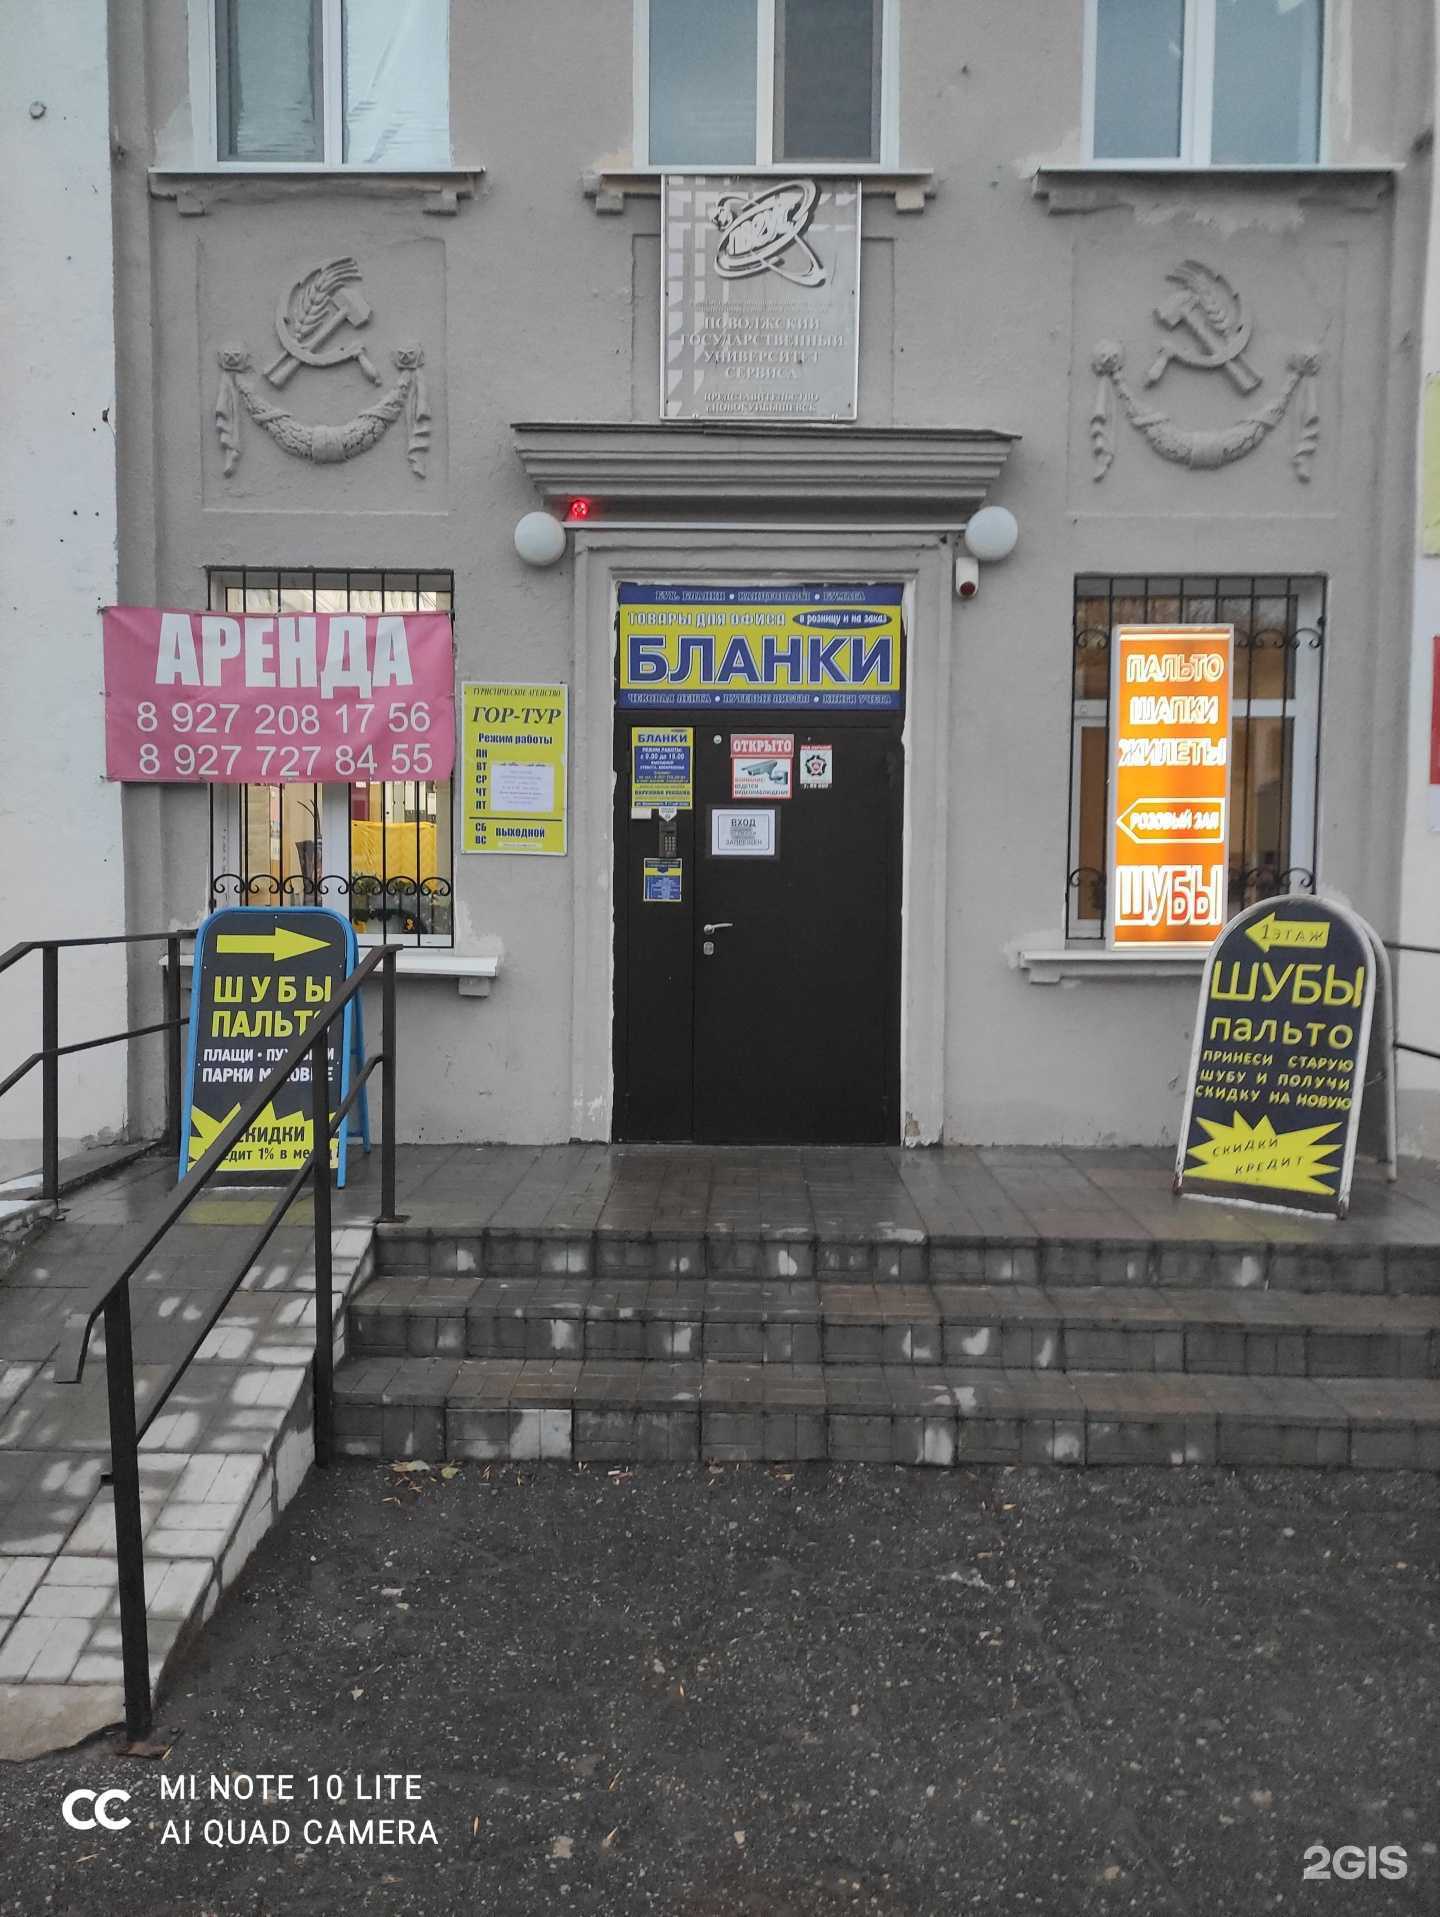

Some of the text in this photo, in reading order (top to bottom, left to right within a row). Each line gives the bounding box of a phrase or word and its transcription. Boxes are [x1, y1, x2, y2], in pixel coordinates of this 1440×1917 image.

[704, 316, 821, 330] ПОВОЛЖСКИЙ
[681, 333, 845, 347] ГОСУДАРСТВЕННЫЙ
[704, 350, 820, 363] УНИВЕРСИТЕТ
[725, 367, 798, 379] СЕРВИСА
[628, 612, 692, 626] ТОВАРЫ
[696, 612, 726, 629] ДЛЯ
[731, 612, 786, 627] ОФИСА
[807, 614, 841, 627] розницу
[843, 614, 849, 623] и
[851, 614, 862, 623] на
[864, 614, 888, 623] заказ
[155, 613, 414, 699] АРЕНДА
[628, 635, 893, 685] БЛАНКИ
[1126, 654, 1224, 682] ПАЛЬТО
[473, 687, 526, 697] ТУРИСТИЧЕСКОЕ
[137, 702, 431, 735] 8 927 208 17 56
[472, 706, 562, 724] ГОР-ТУР
[1129, 696, 1218, 725] ШАПКИ
[478, 732, 553, 745] Режим работы
[638, 734, 688, 743] БЛАНКИ
[733, 740, 792, 753] ОТКРЫТО
[139, 743, 433, 777] 8 927 727 84 55
[1118, 738, 1227, 767] ЖИЛЕТЫ
[476, 762, 487, 771] ВТ
[476, 775, 487, 784] СР
[476, 788, 487, 797] ЧТ
[476, 800, 487, 810] ПТ
[475, 823, 487, 832] СБ
[731, 819, 756, 828] ВХОД
[1115, 865, 1224, 926] ШУБЫ
[213, 975, 332, 1003] ШУБЫ
[1210, 961, 1366, 1008] ШУБЫ
[211, 1010, 329, 1038] ПАЛЬТ
[203, 1049, 254, 1063] ПЛАЩИ
[1203, 1050, 1354, 1072] ПРИНЕСИ СТАРУЮ
[202, 1067, 254, 1082] ПАРКИ
[1200, 1069, 1350, 1092] ШУБУ И ПОЛУЧИ
[1195, 1085, 1352, 1110] СКИДКУ НА НОВУЮ
[258, 1147, 275, 1160] 1%
[1212, 1137, 1278, 1157] СКИДКИ
[1234, 1156, 1304, 1175] КРЕДИТ
